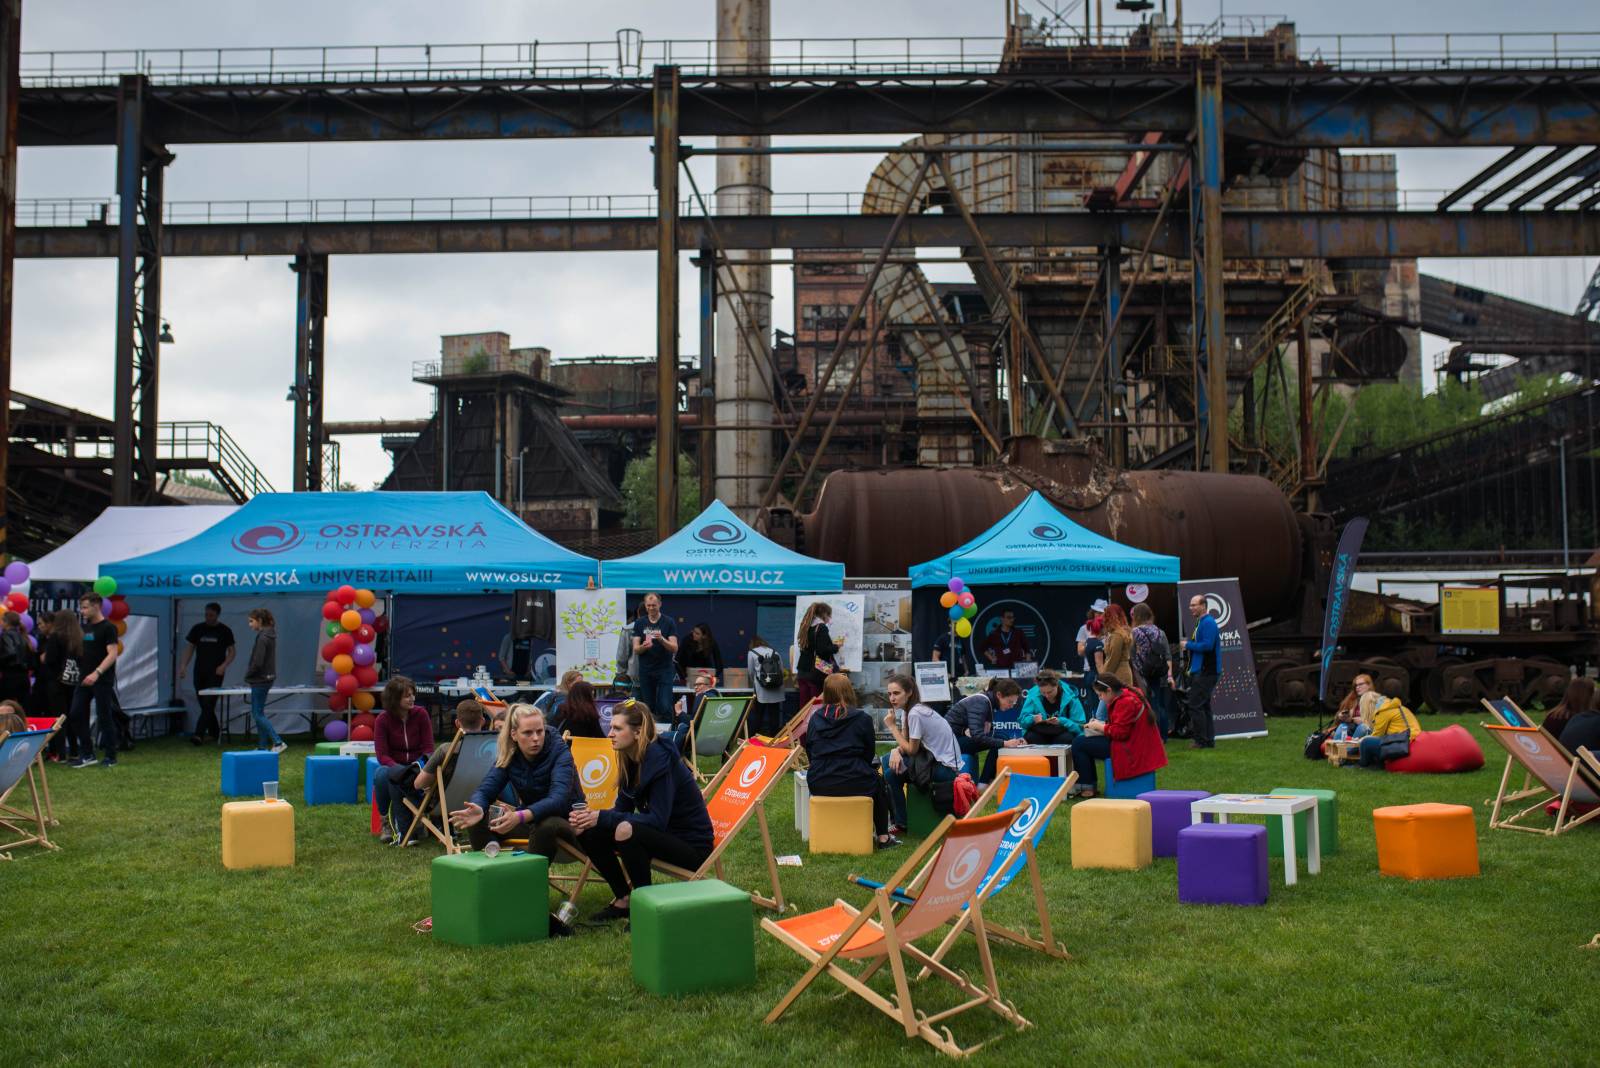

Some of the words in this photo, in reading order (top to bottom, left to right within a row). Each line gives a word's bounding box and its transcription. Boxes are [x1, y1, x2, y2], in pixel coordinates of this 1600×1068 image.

[319, 521, 488, 538] OSTRAVSKÁ
[315, 539, 487, 550] UNIVERZITA
[138, 574, 182, 588] JSME
[191, 569, 300, 587] OSTRAVSKÁ
[1219, 630, 1241, 640] VSKÁ
